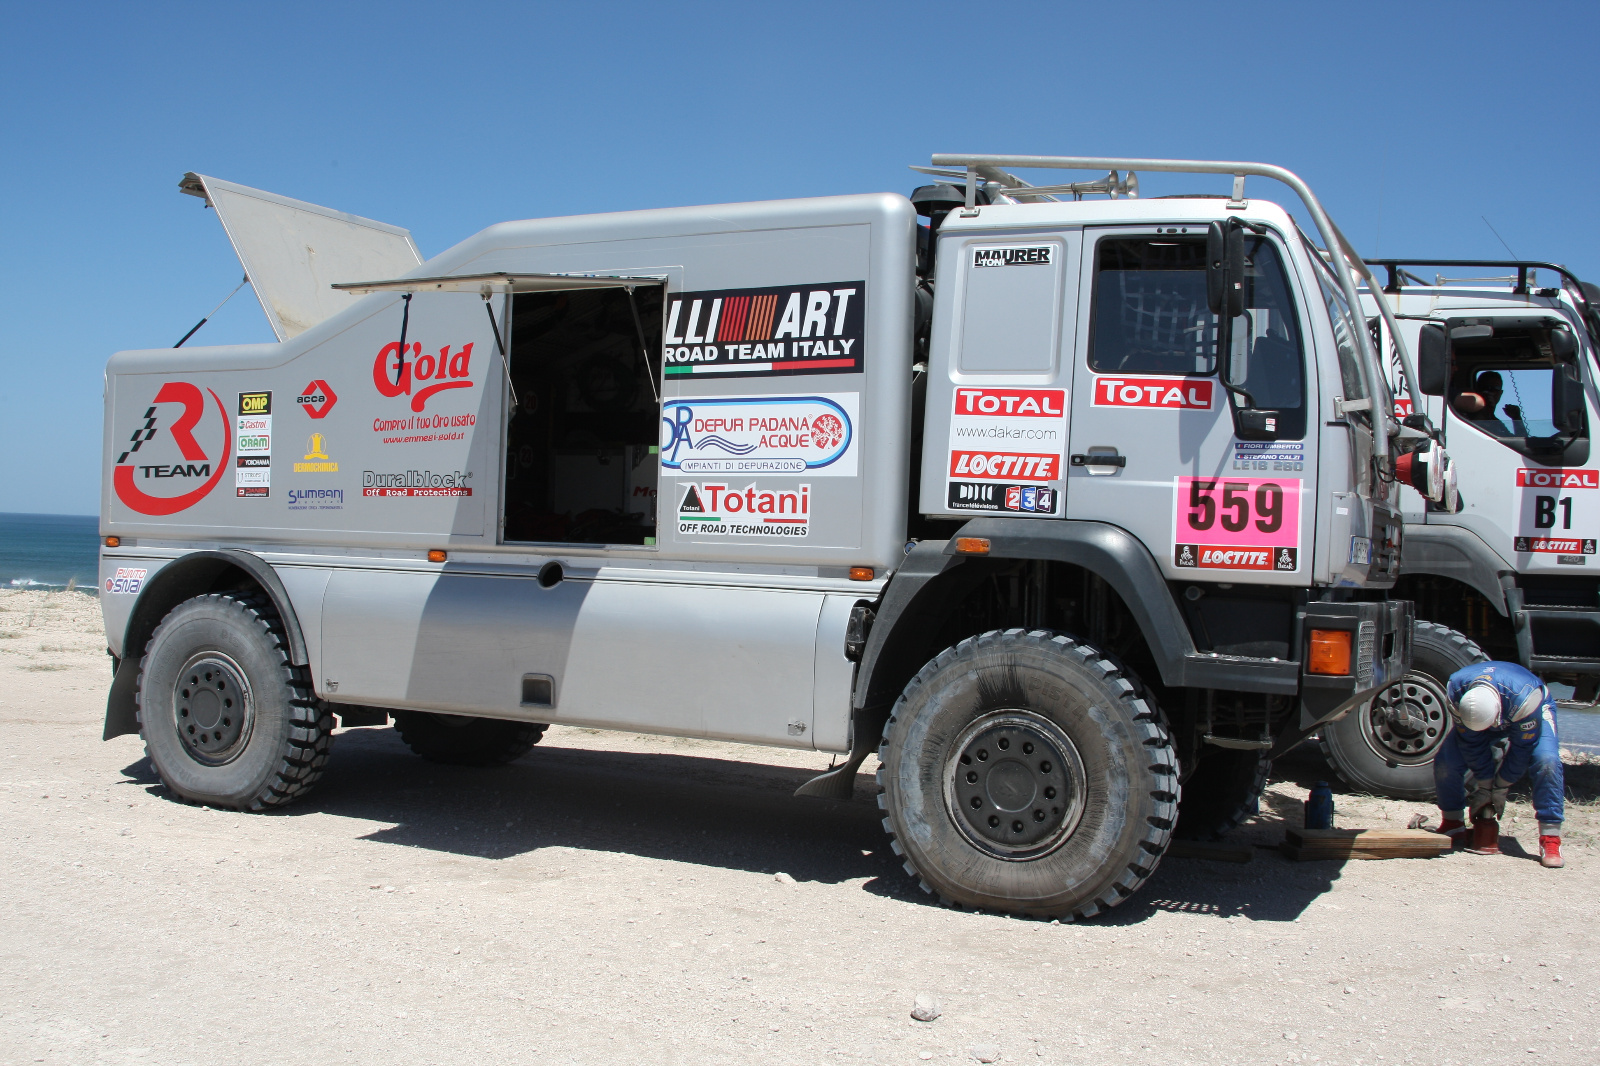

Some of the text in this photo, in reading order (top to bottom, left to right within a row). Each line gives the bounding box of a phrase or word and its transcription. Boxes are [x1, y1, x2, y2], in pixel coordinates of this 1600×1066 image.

[975, 248, 1050, 264] MAURER
[981, 259, 1006, 267] TONI
[774, 288, 857, 340] ART
[665, 338, 855, 363] ROAD TEAM ITALY
[296, 395, 325, 404] acca
[1099, 380, 1208, 406] TOTAL
[242, 397, 268, 411] OMP
[525, 394, 537, 410] 20
[959, 390, 1061, 415] TOTAL
[245, 420, 267, 429] Castrol
[373, 418, 407, 433] Compro
[416, 416, 431, 430] tuo
[432, 413, 450, 429] Oro
[451, 412, 476, 428] usato
[694, 416, 810, 433] DEPUR PADANA
[758, 433, 810, 448] ACQUE
[955, 425, 1058, 440] www.dakar.com
[240, 437, 268, 448] ORAM
[138, 463, 211, 479] TEAM
[685, 461, 803, 470] IMPIANTI DI DEPURAZIONE
[954, 453, 1053, 478] LOCTITE
[1519, 470, 1597, 487] TOTAL
[366, 488, 468, 497] Off Road Protections
[704, 485, 809, 515] Totani
[1009, 493, 1050, 508] 2 3 4
[1187, 480, 1284, 534] 559
[1534, 495, 1573, 530] B1
[680, 524, 808, 536] OFF ROAD TECHNOLOGIES
[1532, 541, 1578, 551] LOCTITE
[1201, 550, 1269, 566] LOCTITE
[116, 568, 147, 579] PUNTO
